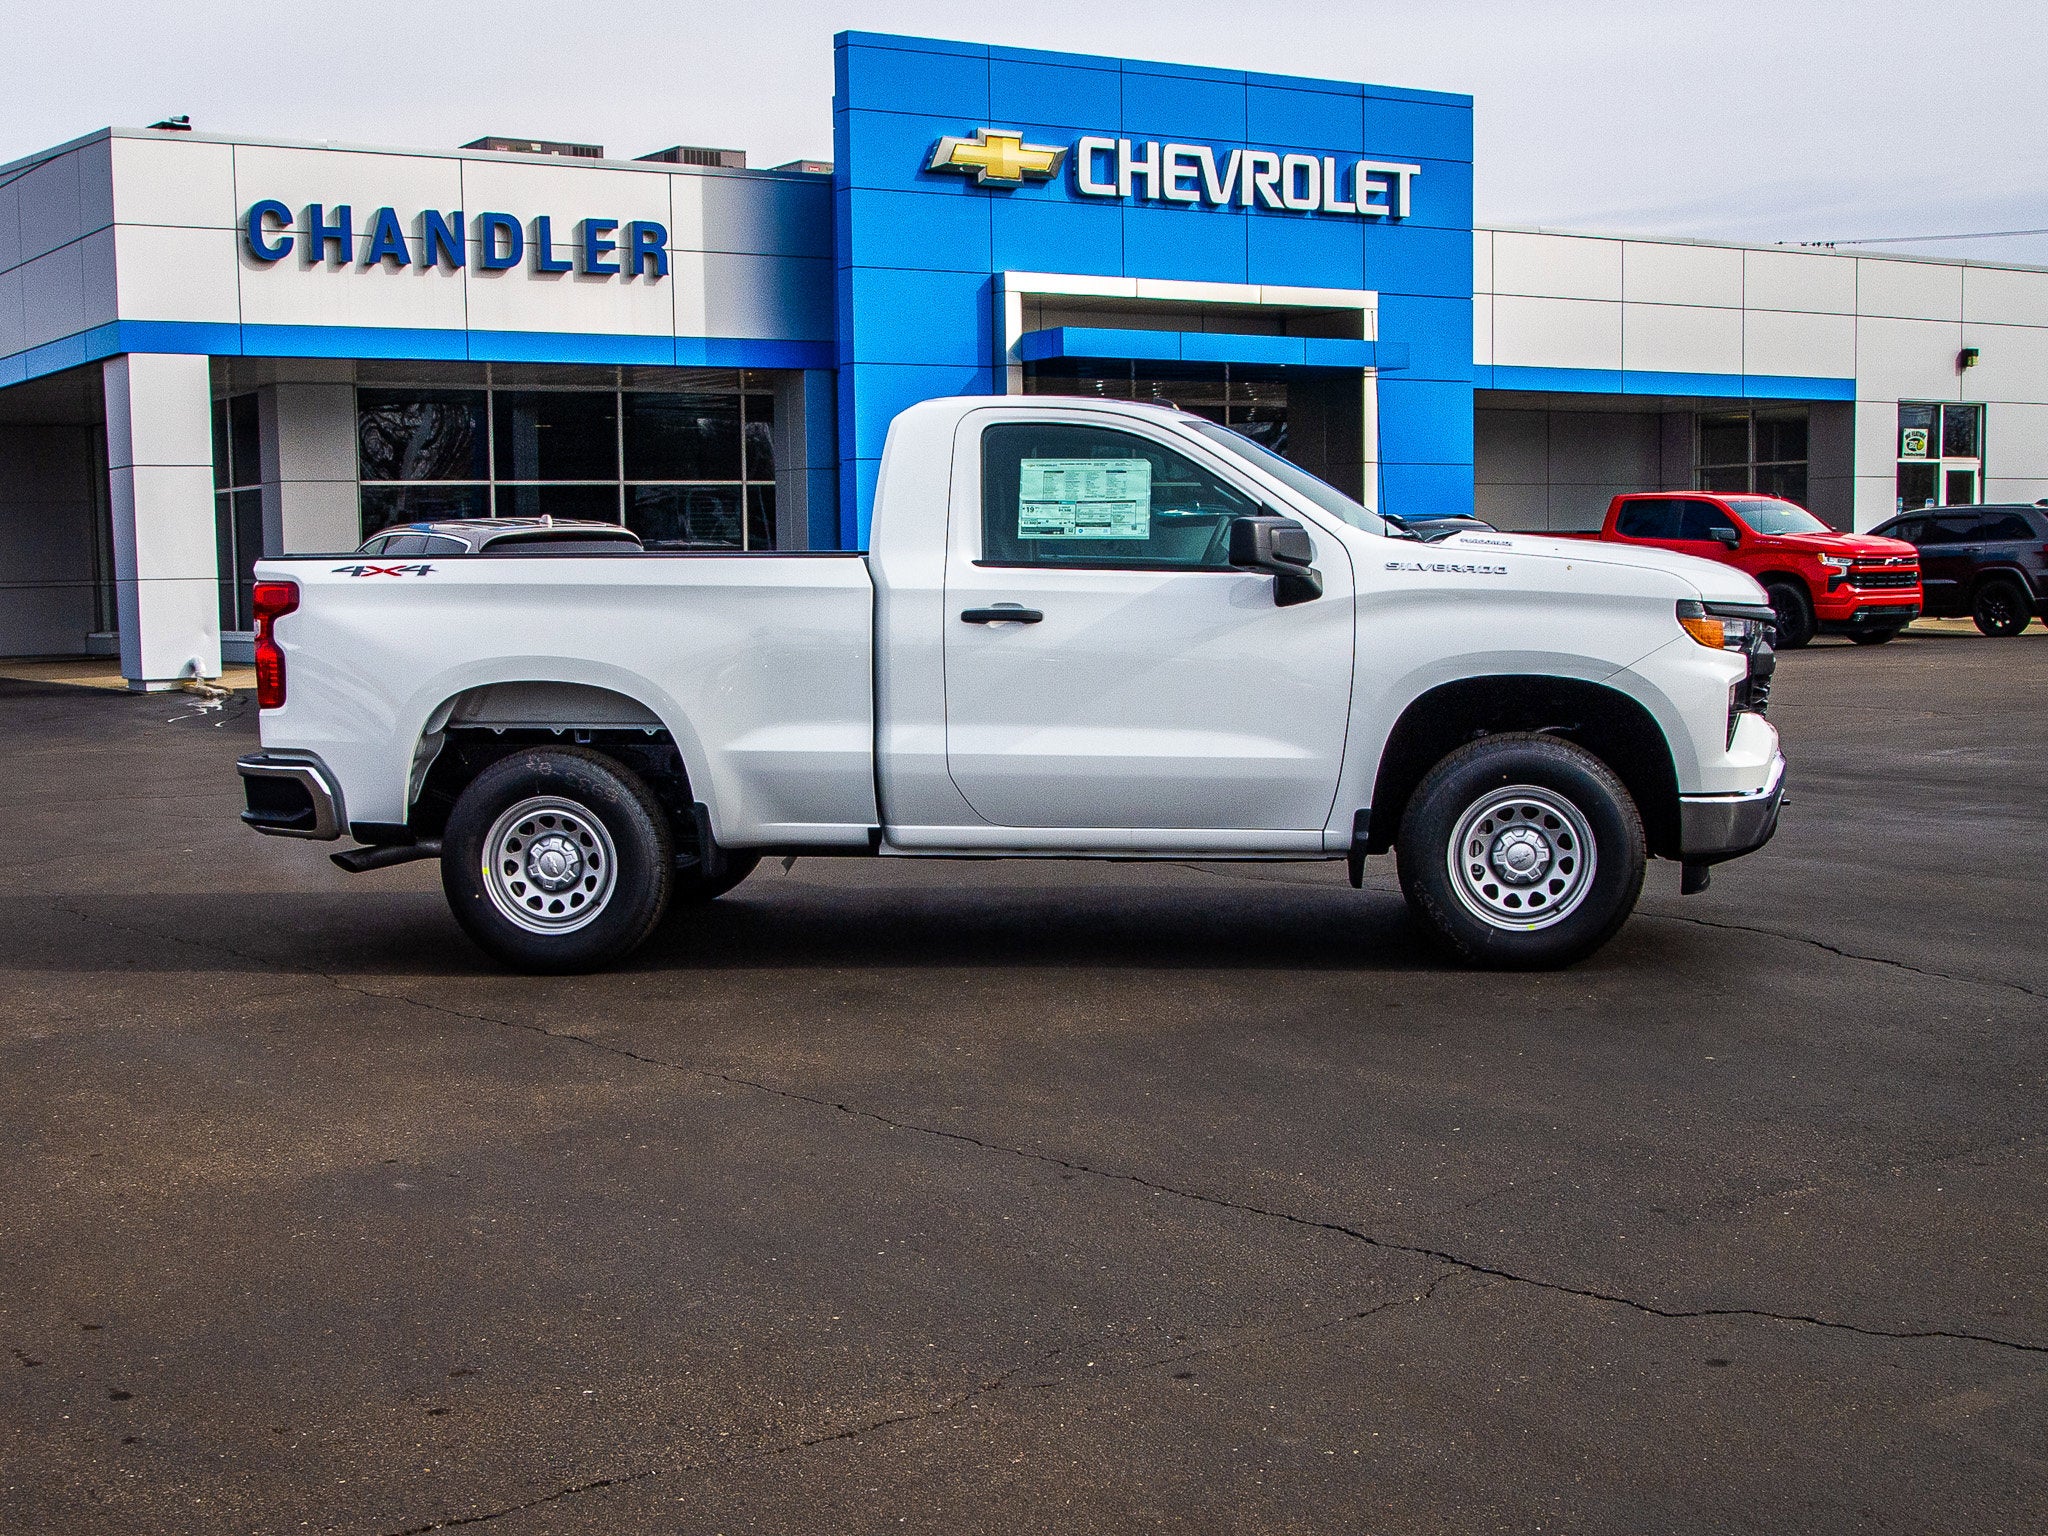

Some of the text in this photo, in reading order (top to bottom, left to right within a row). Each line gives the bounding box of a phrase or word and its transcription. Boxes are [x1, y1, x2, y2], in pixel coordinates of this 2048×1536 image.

[1078, 136, 1421, 218] CHEVROLET
[246, 199, 670, 277] CHANDLER
[331, 565, 438, 577] 4X4
[1384, 562, 1508, 575] SILVERADO
